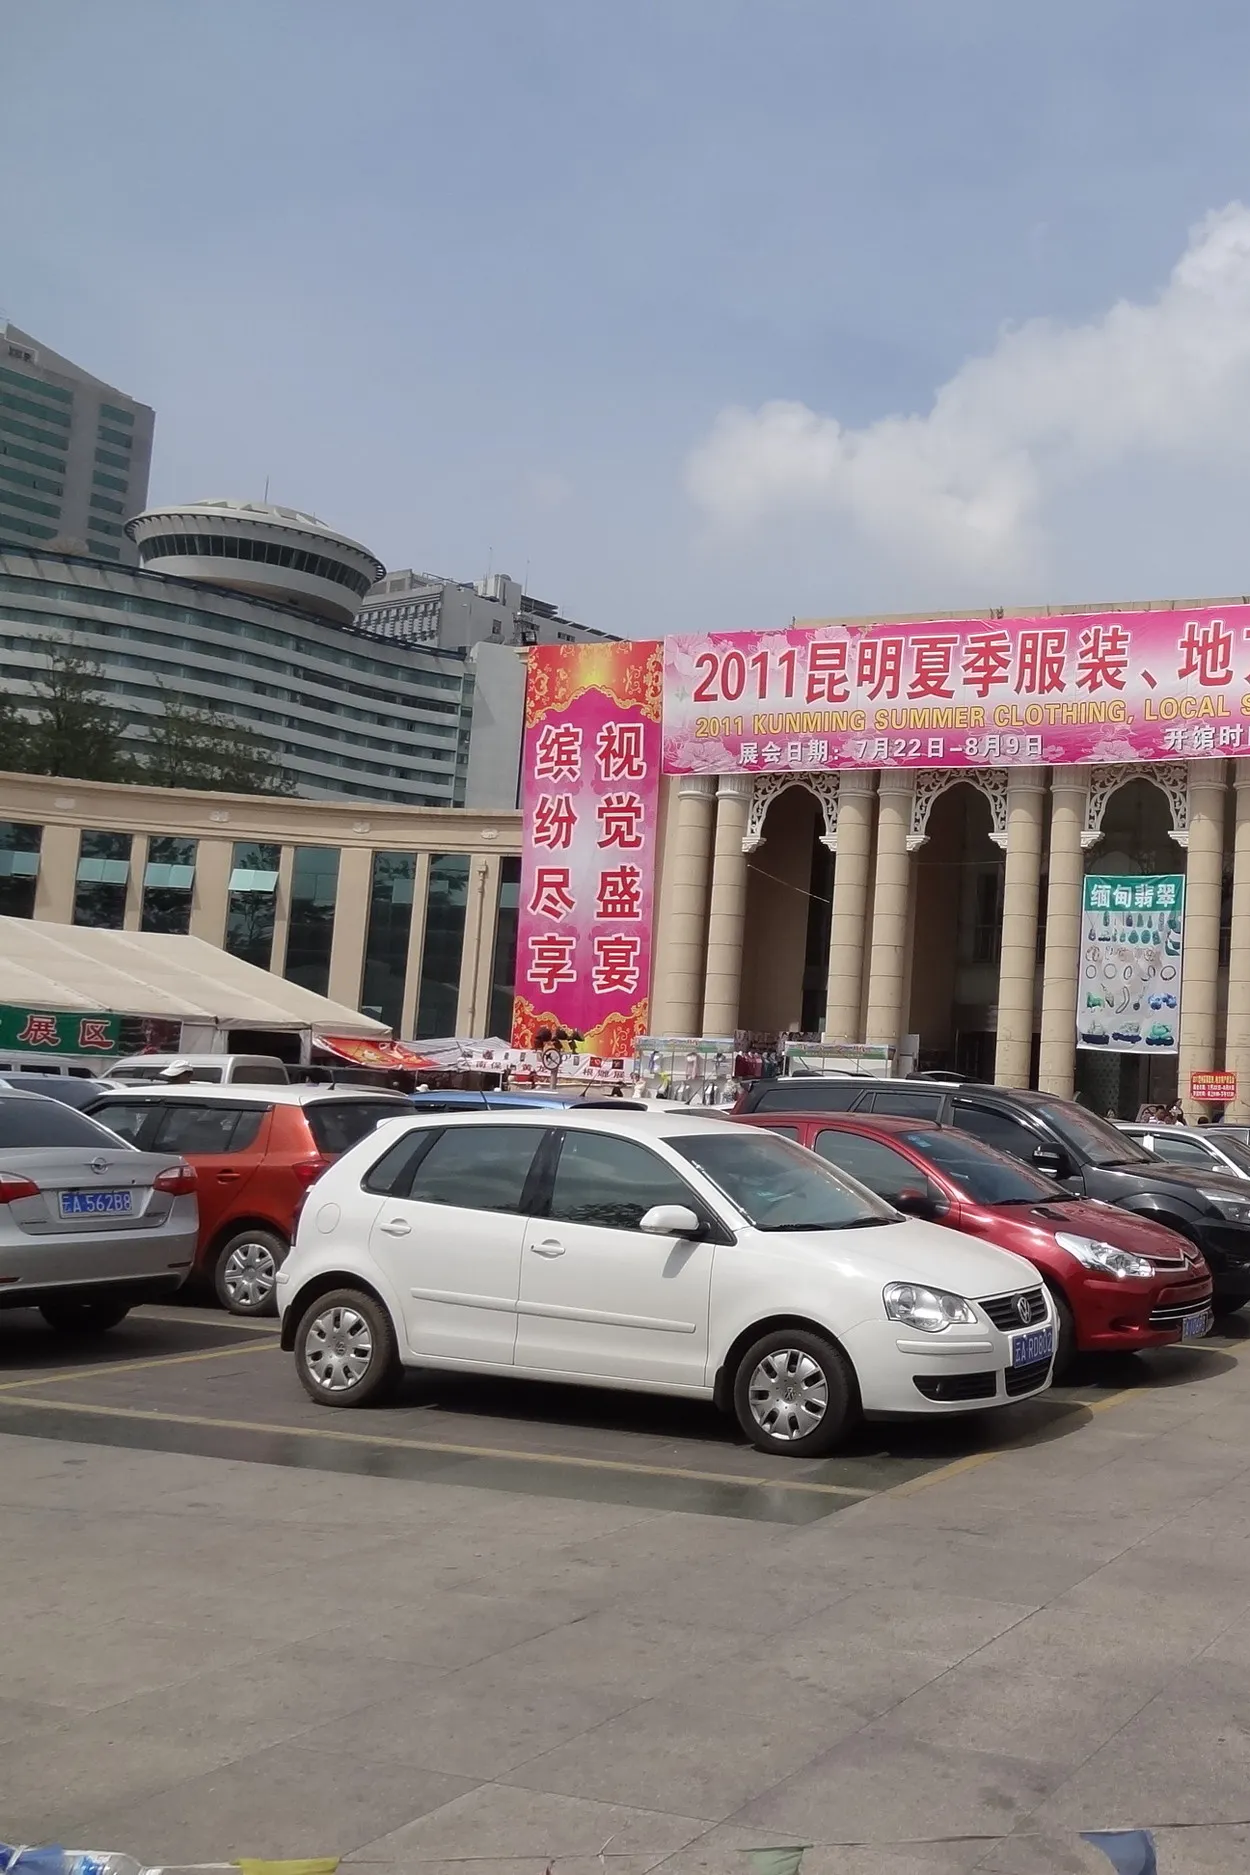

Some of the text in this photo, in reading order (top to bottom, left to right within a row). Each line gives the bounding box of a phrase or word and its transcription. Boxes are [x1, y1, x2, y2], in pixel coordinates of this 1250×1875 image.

[696, 715, 743, 738] 2011
[753, 710, 865, 735] KUNMING
[874, 705, 984, 731] SUMMER
[995, 700, 1134, 727] CLOTHING,
[1144, 693, 1230, 721] LOCAL
[527, 722, 583, 994] 缤纷尽享
[594, 721, 648, 995] 视觉盛宴
[1090, 883, 1177, 908] 缅甸翡翠
[16, 1014, 115, 1050] 展区
